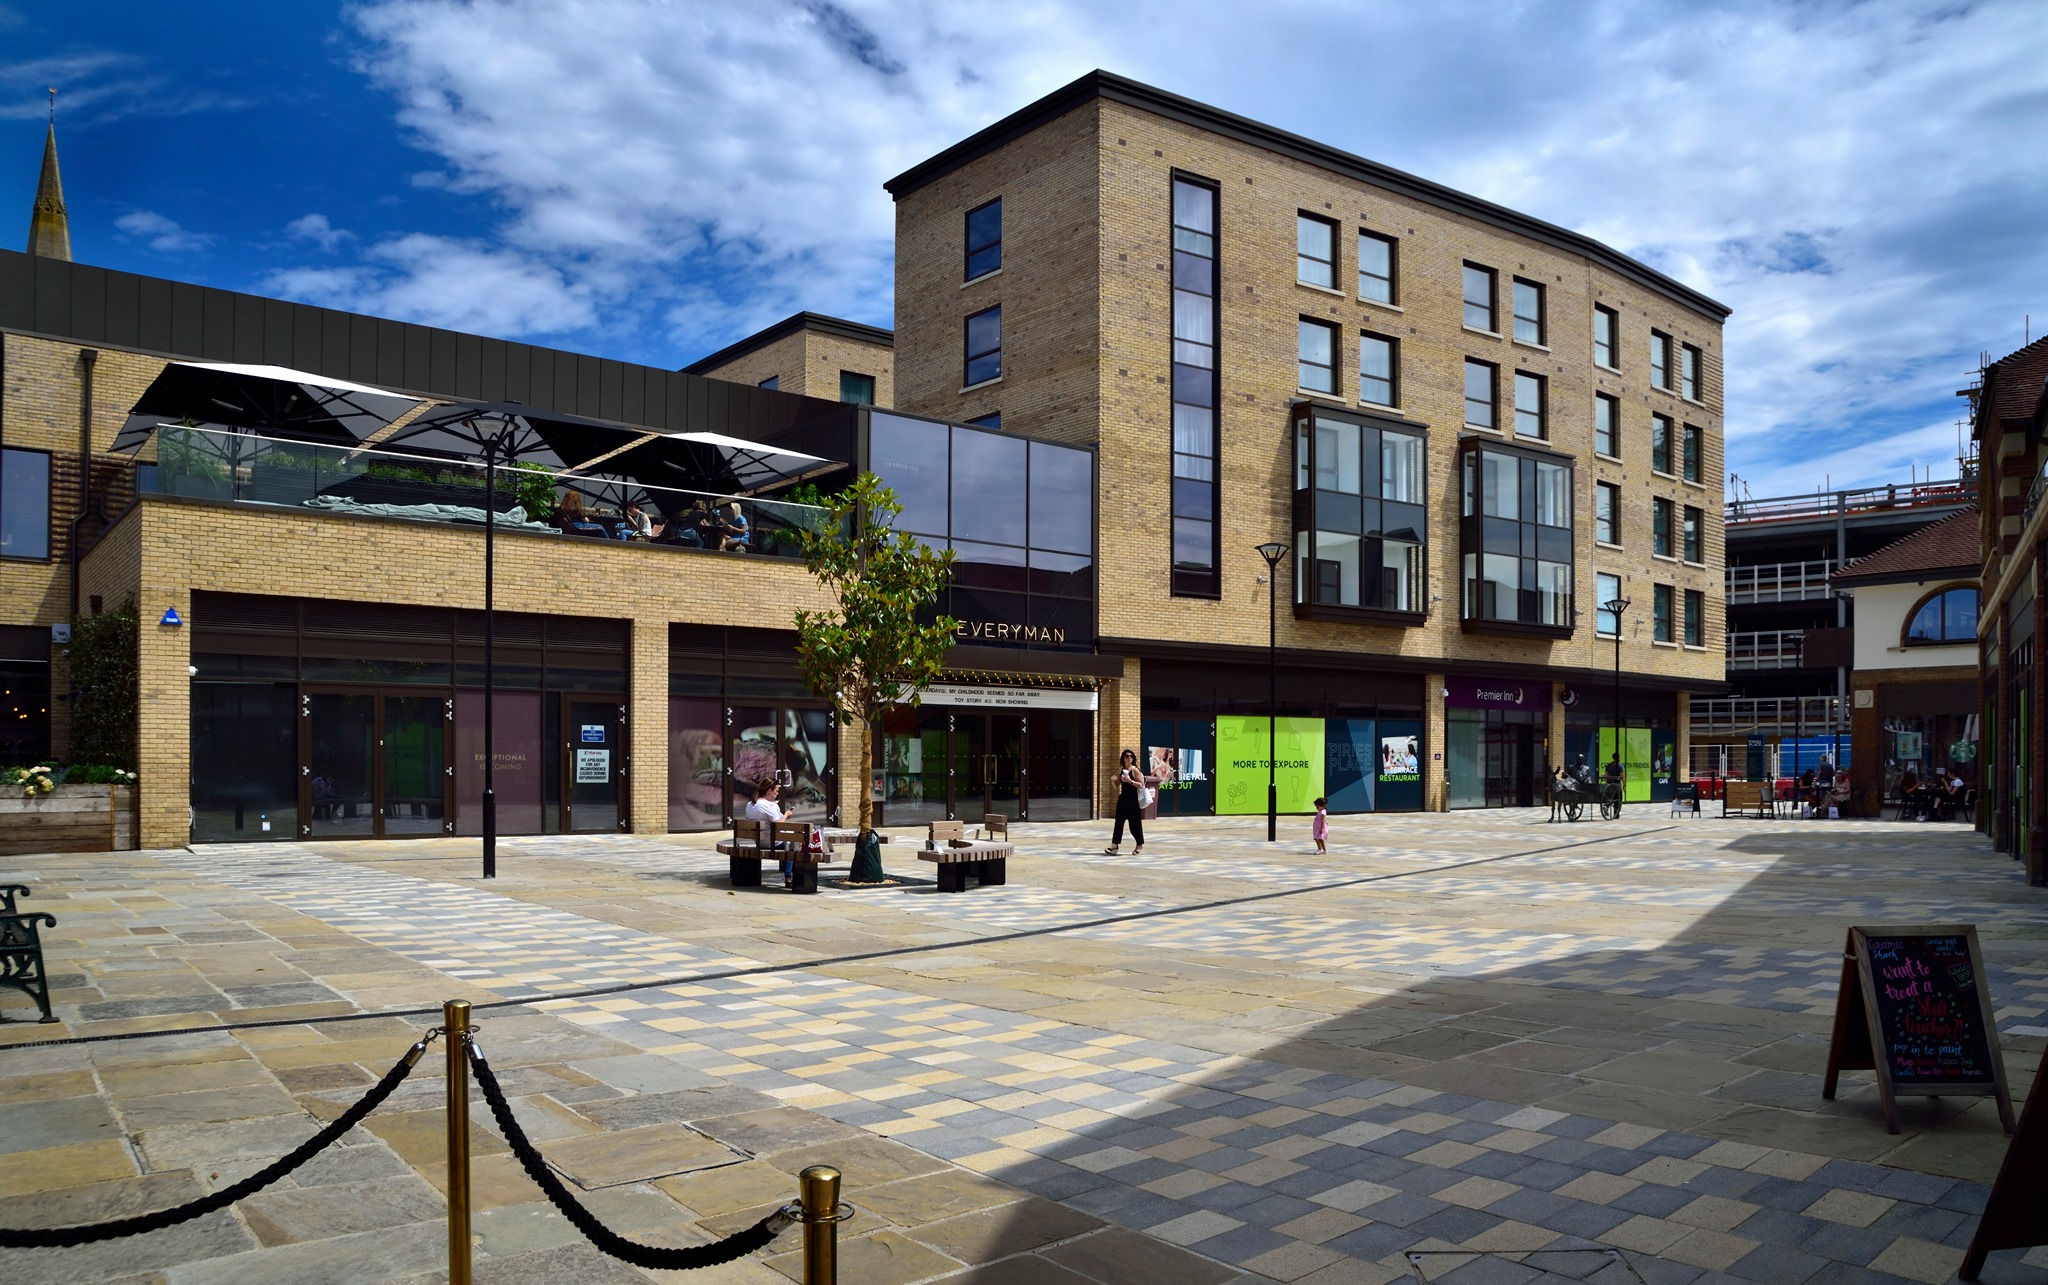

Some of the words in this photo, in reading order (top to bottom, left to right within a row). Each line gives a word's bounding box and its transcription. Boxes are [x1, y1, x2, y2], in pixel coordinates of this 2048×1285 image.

[957, 620, 1065, 642] EVERYMAN
[958, 688, 985, 696] CHILDHOOD
[1477, 689, 1503, 701] Premier
[1504, 690, 1514, 701] Inn
[1327, 743, 1373, 757] PIRIES
[1233, 760, 1257, 768] MORE
[1259, 760, 1270, 768] TO
[1274, 760, 1309, 768] EXPLORE
[1329, 758, 1375, 777] PLACE
[1181, 772, 1207, 781] RETAIL
[1379, 774, 1420, 782] RESTAURANT
[1159, 782, 1174, 790] AYS
[1867, 938, 1904, 950] Ceramic
[1872, 949, 1899, 960] Shack
[1882, 957, 1917, 980] want
[1916, 960, 1930, 976] to
[1885, 980, 1920, 1001] treat
[1923, 981, 1933, 993] a
[1892, 1043, 1909, 1054] pop
[1911, 1045, 1921, 1056] in
[1924, 1045, 1935, 1055] to
[1938, 1043, 1963, 1056] paint
